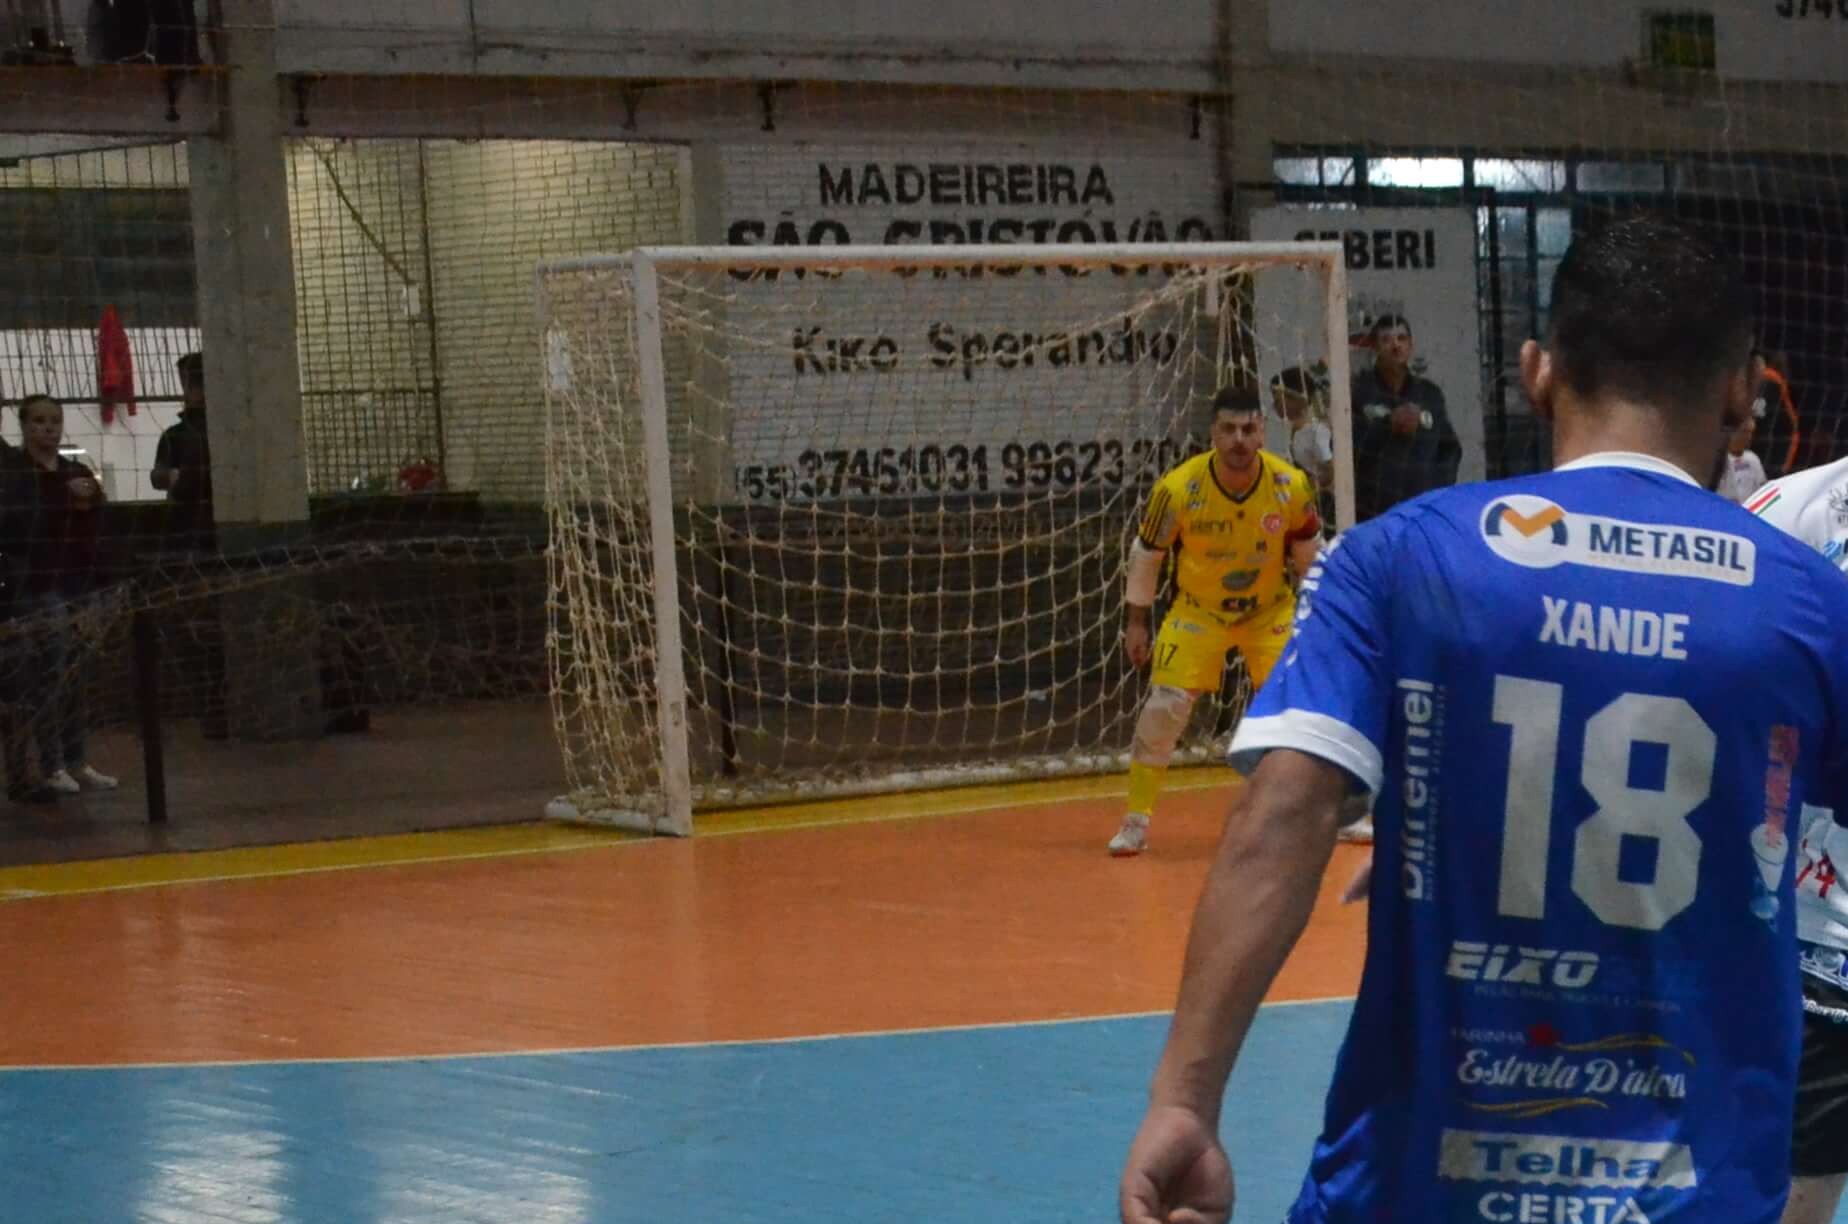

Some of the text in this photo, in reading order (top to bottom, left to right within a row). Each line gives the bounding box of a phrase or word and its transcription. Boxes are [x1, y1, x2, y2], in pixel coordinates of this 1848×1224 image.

[819, 163, 1114, 205] MADEIREIRA
[792, 317, 1178, 381] Kiko Sperandio
[1589, 523, 1747, 572] METASIL
[1539, 595, 1690, 660] XANDE
[1491, 673, 1718, 931] 18
[1472, 1139, 1663, 1181] Telha
